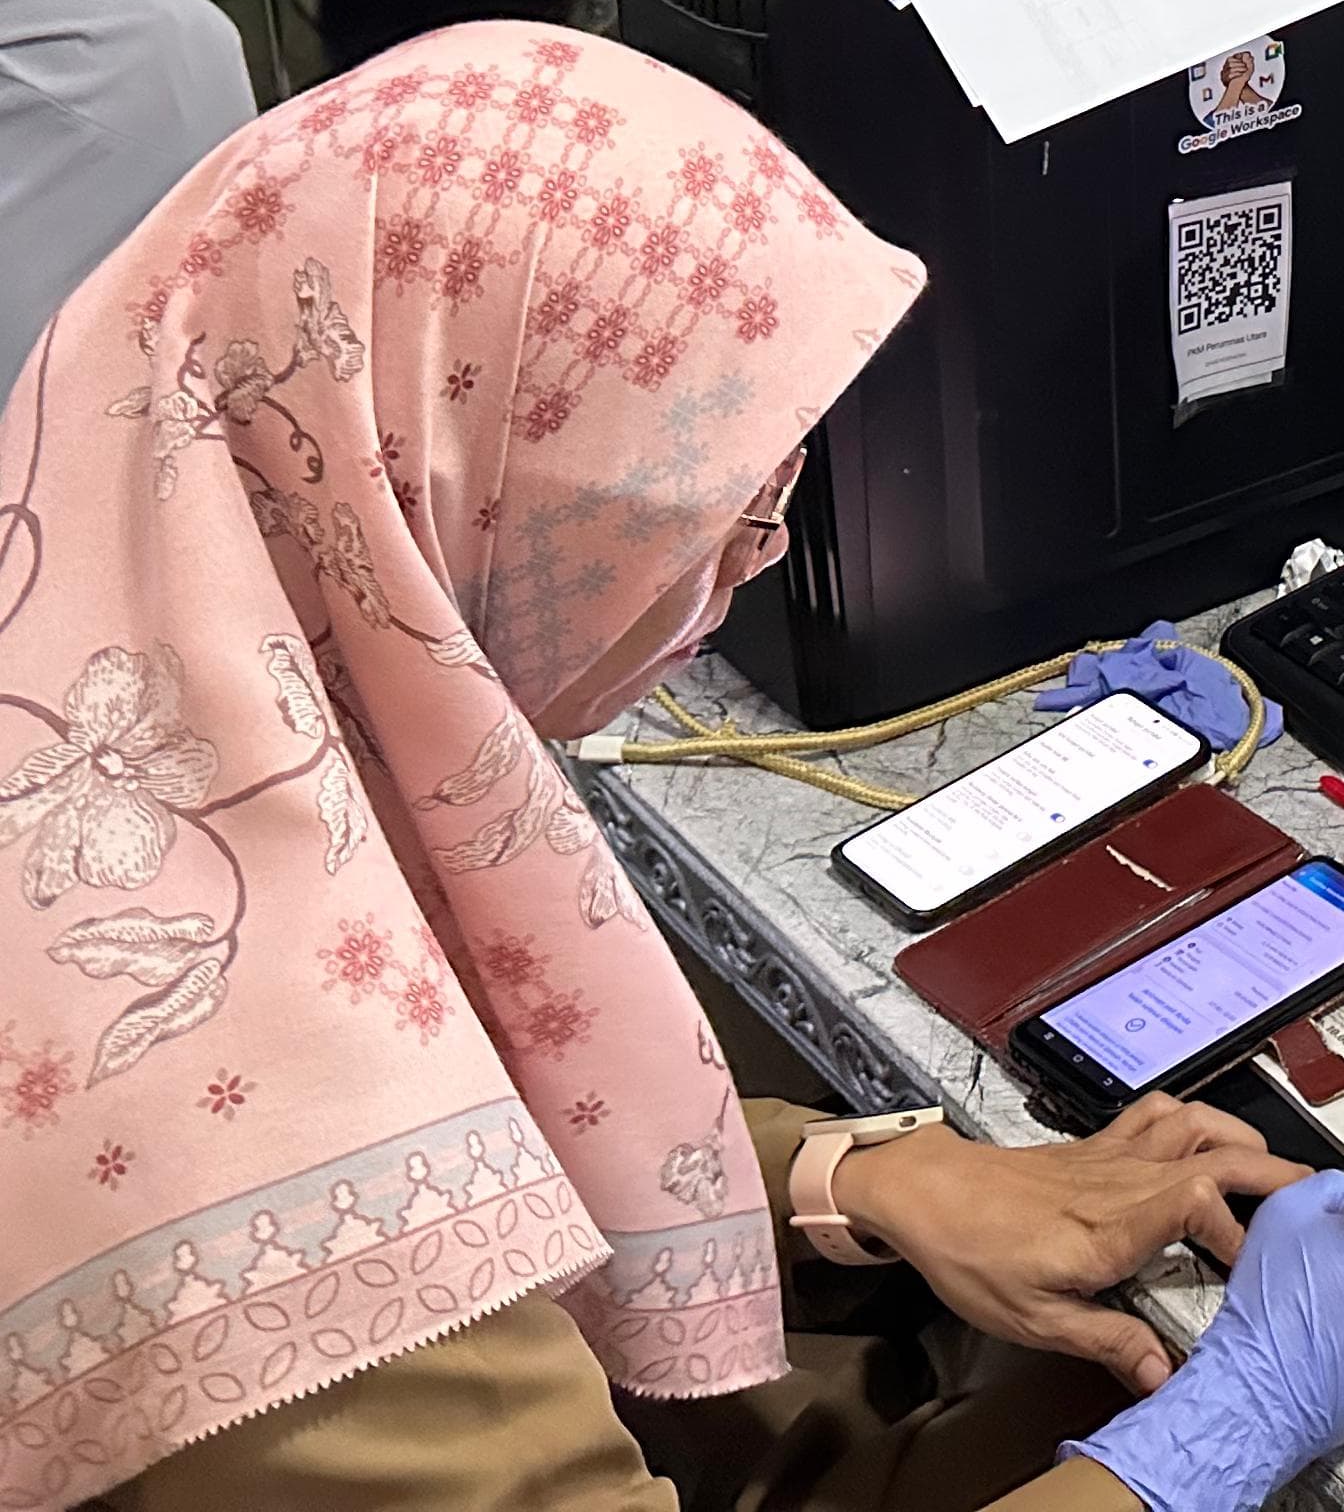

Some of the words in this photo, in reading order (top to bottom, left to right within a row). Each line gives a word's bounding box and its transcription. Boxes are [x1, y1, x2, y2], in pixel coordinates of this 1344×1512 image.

[1181, 129, 1228, 150] Google
[1231, 106, 1299, 134] Workspace
[1215, 110, 1240, 126] This
[1244, 106, 1255, 116] is
[1258, 104, 1264, 112] a
